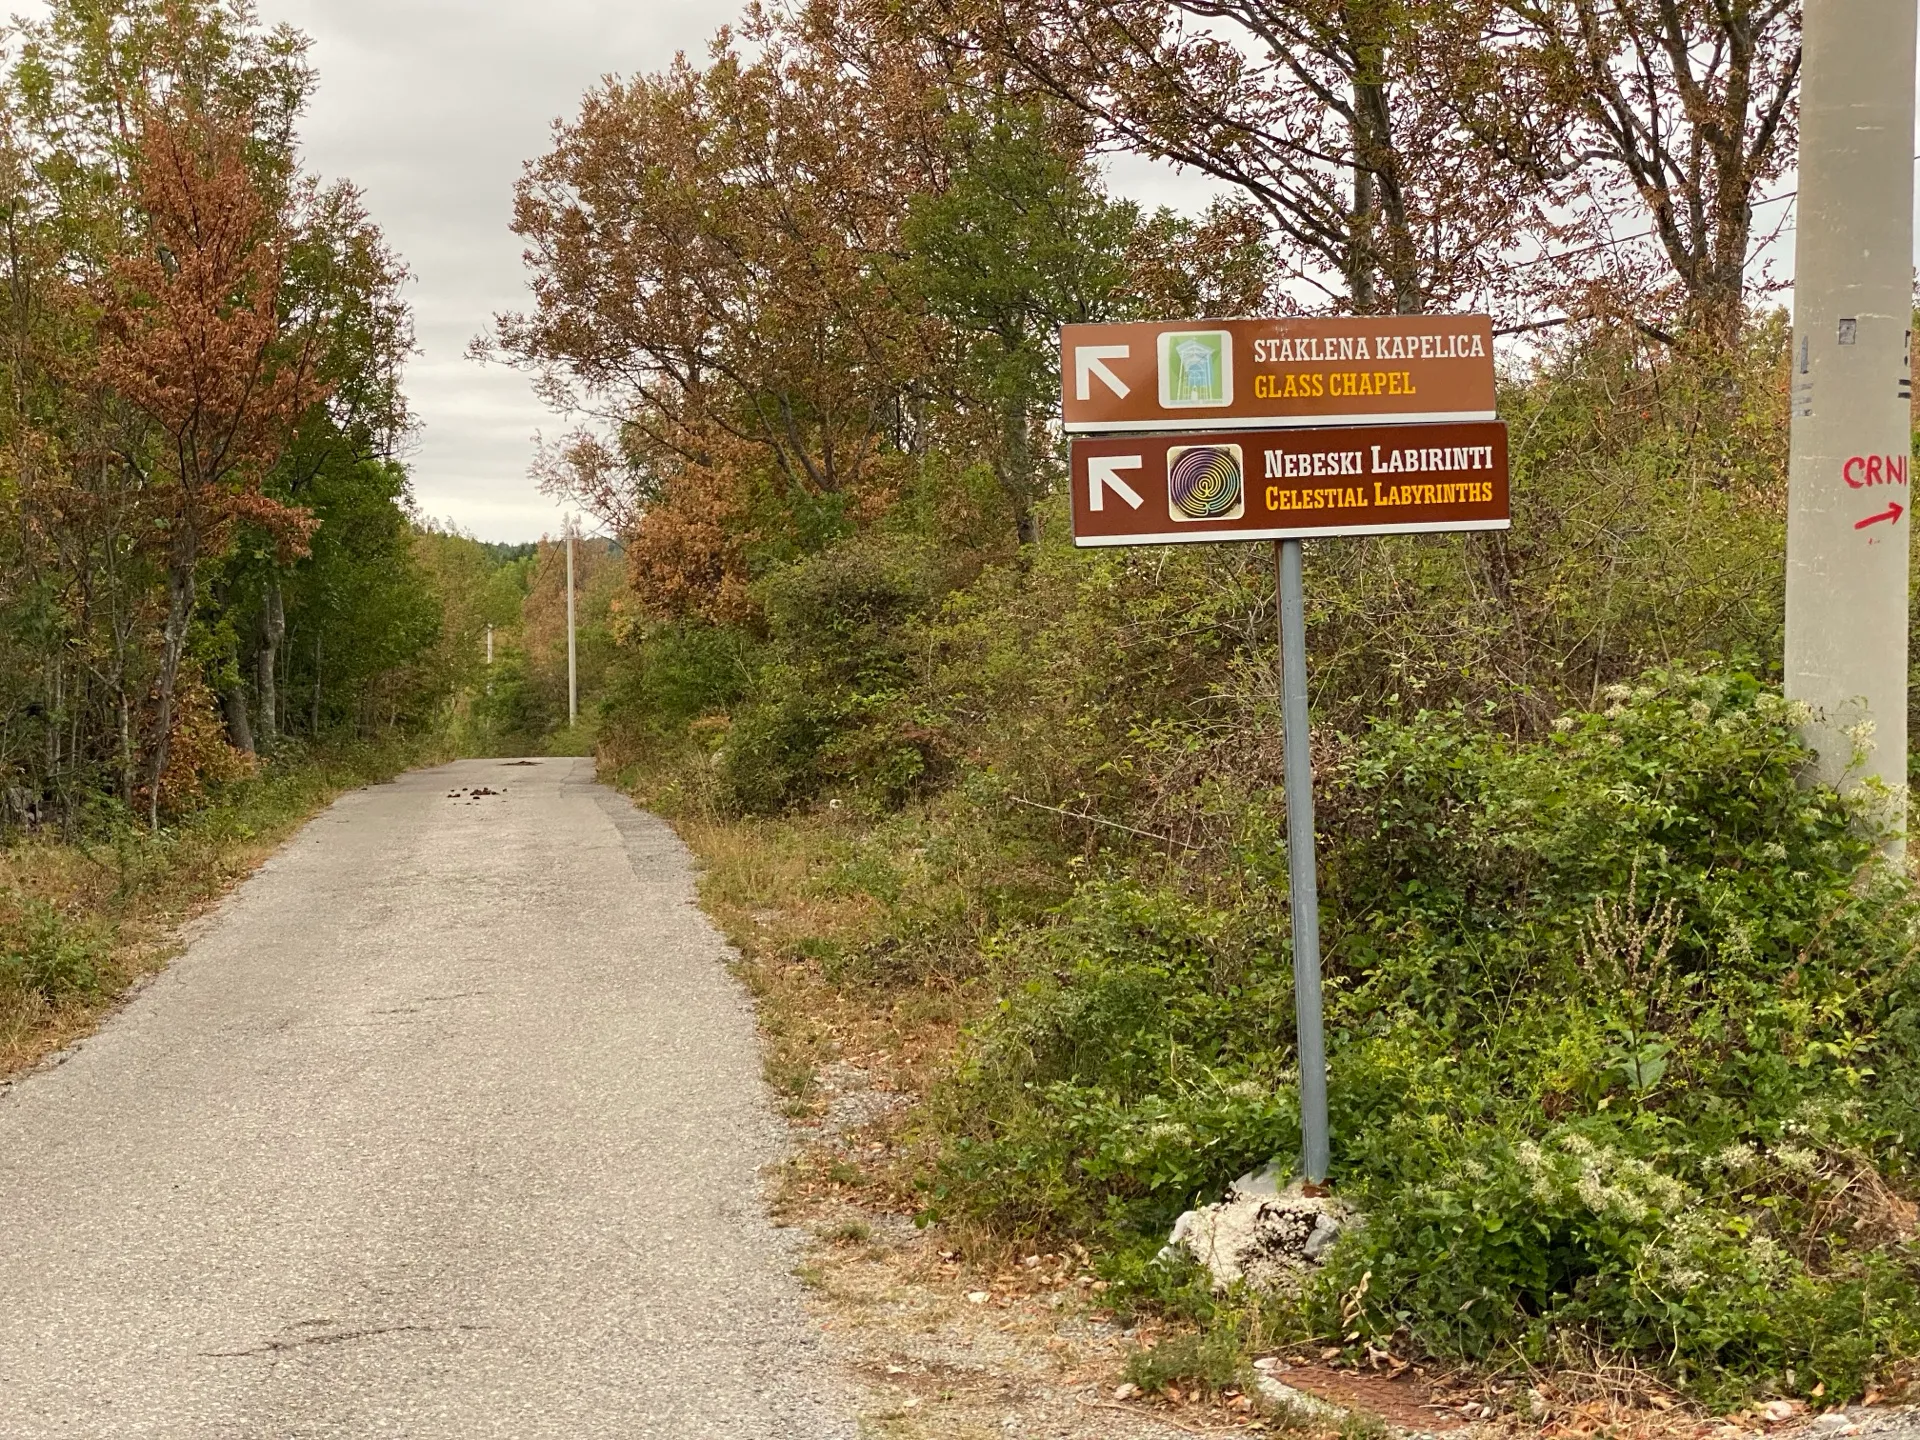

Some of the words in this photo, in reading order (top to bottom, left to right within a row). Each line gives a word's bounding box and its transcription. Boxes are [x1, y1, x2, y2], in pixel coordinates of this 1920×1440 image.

[1254, 337, 1369, 362] STAKLENA
[1375, 334, 1485, 360] KAPELICA
[1254, 374, 1324, 399] GLASS
[1329, 371, 1416, 397] CHAPEL
[1264, 449, 1363, 478] NEBESKI
[1371, 445, 1493, 474] LABIRINTI
[1265, 485, 1368, 511] CELESTIAL
[1374, 481, 1493, 506] LABYRINTHS
